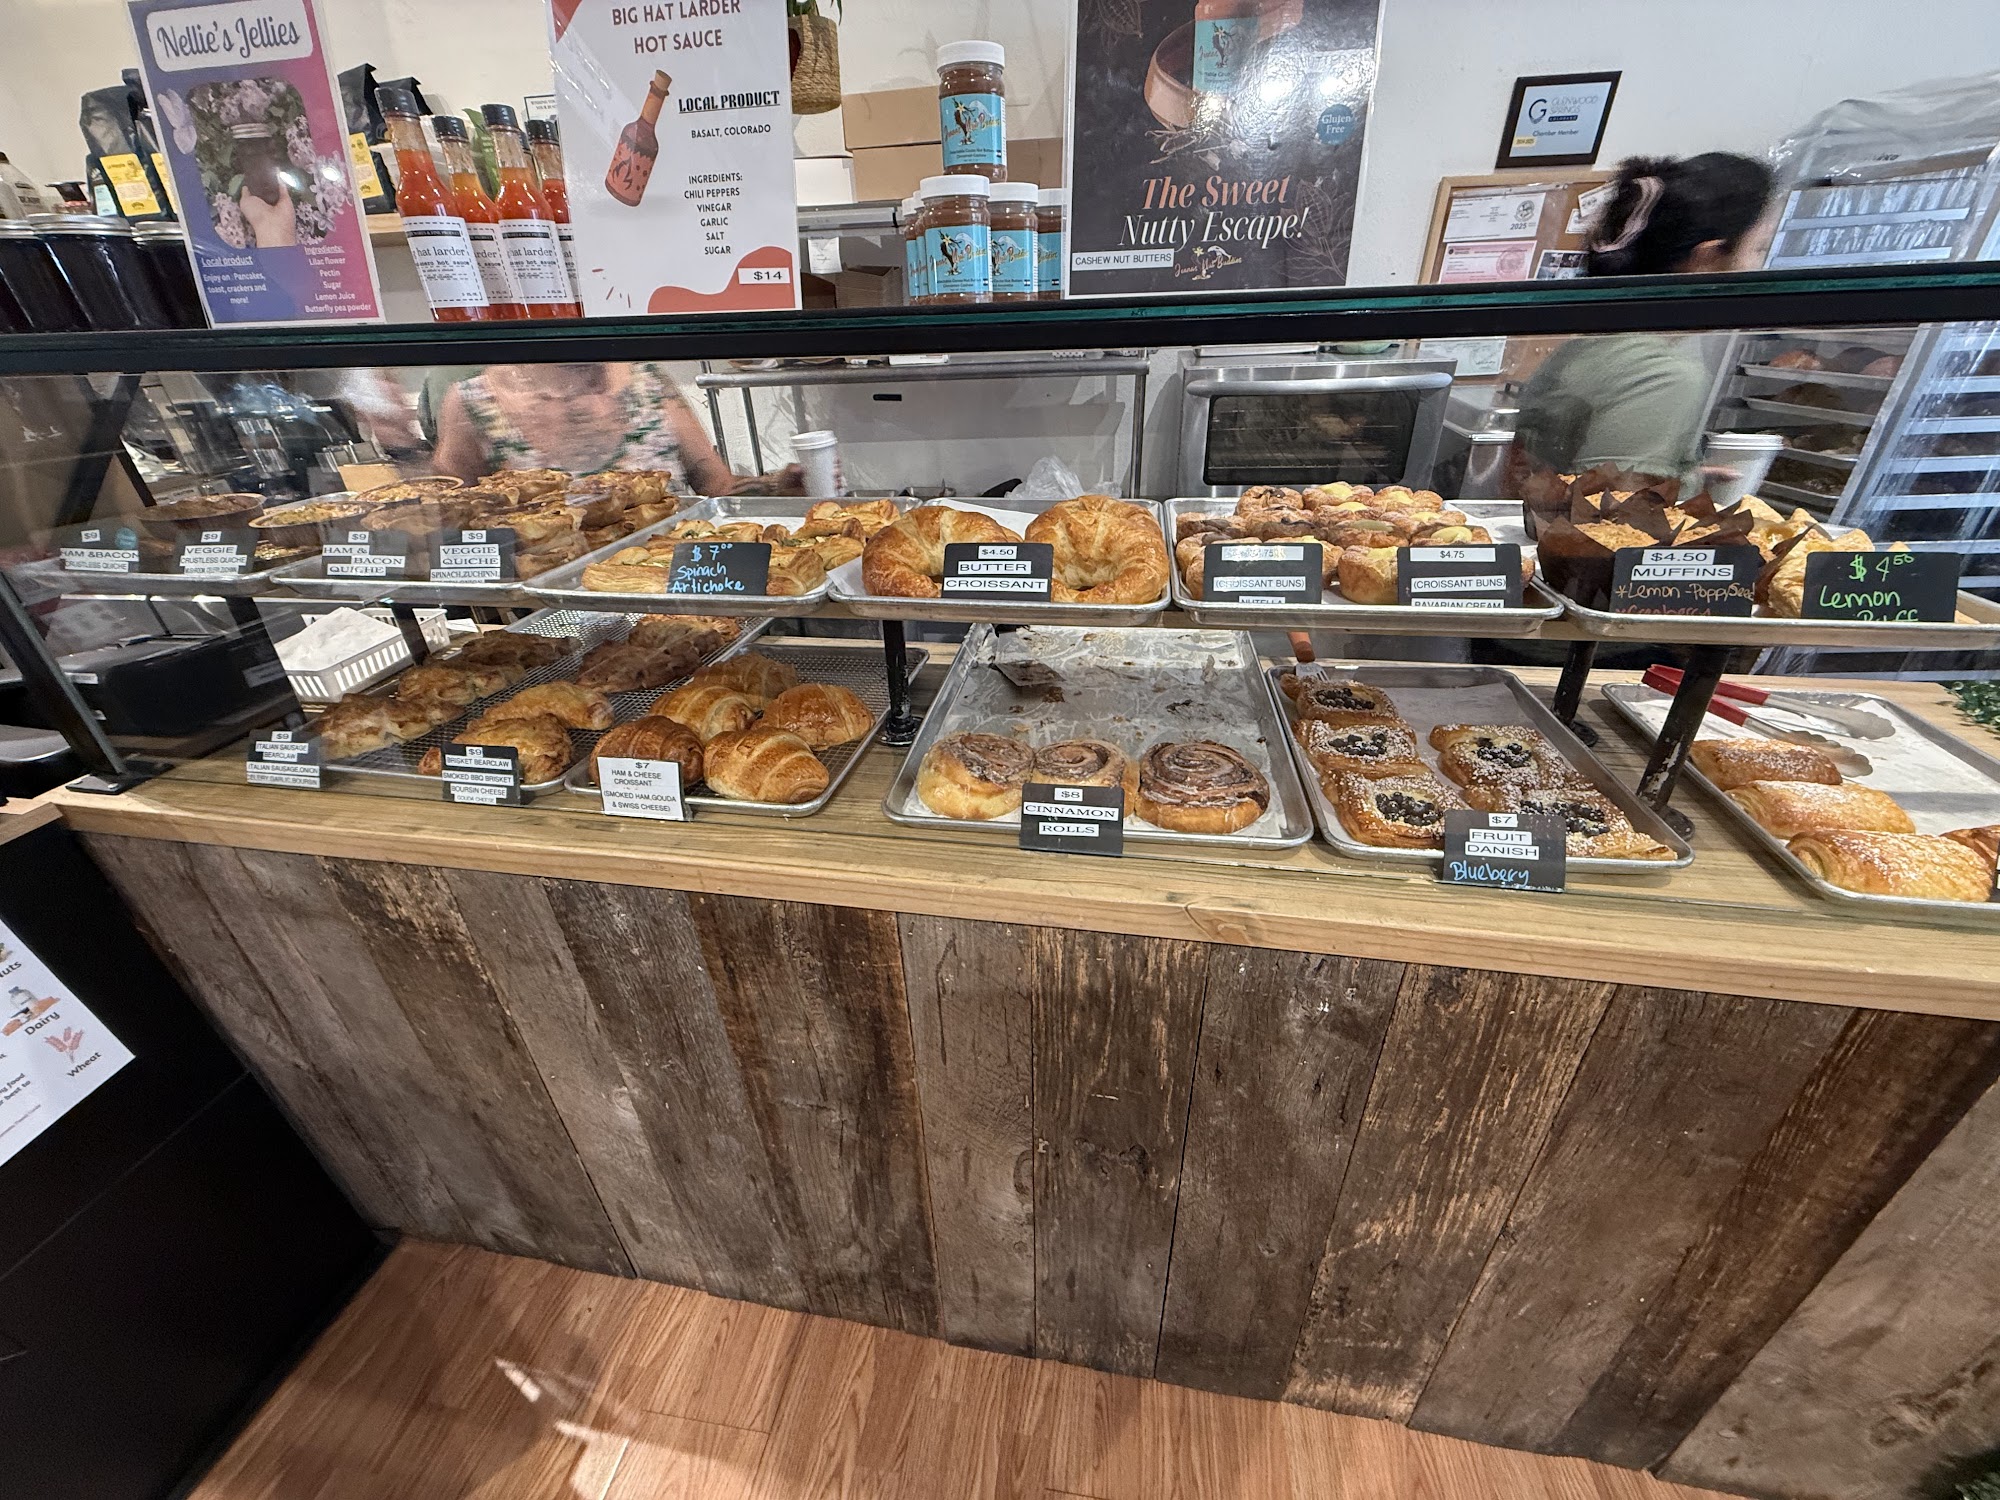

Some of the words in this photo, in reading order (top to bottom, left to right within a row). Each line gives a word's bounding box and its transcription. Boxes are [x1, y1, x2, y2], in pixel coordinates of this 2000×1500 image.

[612, 7, 638, 25] BIG
[643, 3, 674, 22] HAT
[680, 0, 741, 19] LARDER
[157, 21, 234, 58] Nellie's
[235, 16, 300, 58] Jellies
[634, 35, 667, 54] HOT
[673, 29, 723, 51] SAUCE
[678, 96, 719, 112] LOCAL
[720, 90, 780, 109] PRODUCT
[1322, 114, 1351, 124] Gluten
[691, 128, 722, 138] BASALT,
[724, 124, 771, 136] COLORADO
[1326, 124, 1345, 134] Free
[688, 173, 743, 185] INGREDIENTS:
[684, 190, 705, 200] CHILI
[706, 187, 740, 198] PEPPERS
[1142, 176, 1196, 210] The
[1201, 174, 1292, 207] Sweet
[696, 203, 732, 213] VINEGAR
[700, 217, 728, 227] GARLIC
[1510, 222, 1527, 231] 2025
[1117, 214, 1195, 252] Nutty
[1200, 207, 1310, 250] Escape!
[706, 231, 725, 241] SALT
[432, 246, 466, 256] larder
[523, 247, 553, 257] larder
[704, 245, 731, 255] SUGAR
[324, 257, 346, 265] flower
[1075, 257, 1112, 265] CASHEW
[1113, 256, 1129, 264] NUT
[1133, 254, 1172, 263] BUTTERS
[203, 274, 221, 282] Enjoy
[753, 270, 783, 281] $14
[226, 285, 254, 293] crackers
[254, 284, 267, 292] and
[322, 281, 342, 290] Sugar
[304, 305, 334, 314] Butterfly
[334, 305, 347, 313] pea
[346, 304, 372, 312] powder
[84, 531, 98, 540] $9
[468, 531, 484, 540] $9
[442, 546, 497, 555] VEGGIE
[981, 548, 1014, 556] $4.50
[1439, 550, 1465, 559] $4.75
[353, 557, 403, 565] BACON
[442, 557, 499, 566] QUICHE
[1650, 552, 1708, 562] $4.50
[673, 562, 727, 581] Spinach
[960, 563, 1027, 572] BUTTER
[1633, 567, 1732, 577] MUFFINS
[668, 577, 745, 594] Artichoke
[946, 579, 1046, 589] CROISSANT
[1275, 579, 1305, 588] BUNS)
[1413, 580, 1472, 590] (CROISSANT
[1475, 578, 1507, 588] BUNS)
[1819, 585, 1901, 609] Lemon
[280, 744, 307, 752] SAUSAGE
[468, 748, 482, 756] $9
[447, 756, 473, 765] BRISKET
[474, 759, 509, 767] BEARCLAW
[248, 763, 271, 771] ITALIAN
[443, 772, 470, 780] SMOKED
[485, 775, 512, 784] BRISKET
[611, 769, 627, 777] HAM
[633, 771, 662, 779] CHEESE
[613, 778, 653, 787] CROISSANT
[451, 785, 480, 794] BOURSIN
[480, 787, 506, 796] CHEESE
[603, 790, 634, 799] (SMOKED
[1061, 790, 1081, 799] $8
[618, 802, 640, 810] SWISS
[640, 803, 671, 812] CHEESE)
[1025, 804, 1116, 818] CINNAMON
[1491, 815, 1513, 824] $7
[1042, 825, 1095, 833] ROLLS
[1471, 831, 1527, 841] FRUIT
[1467, 844, 1537, 856] DANISH
[24, 1011, 61, 1036] Dairy
[66, 1051, 102, 1078] Wheat
